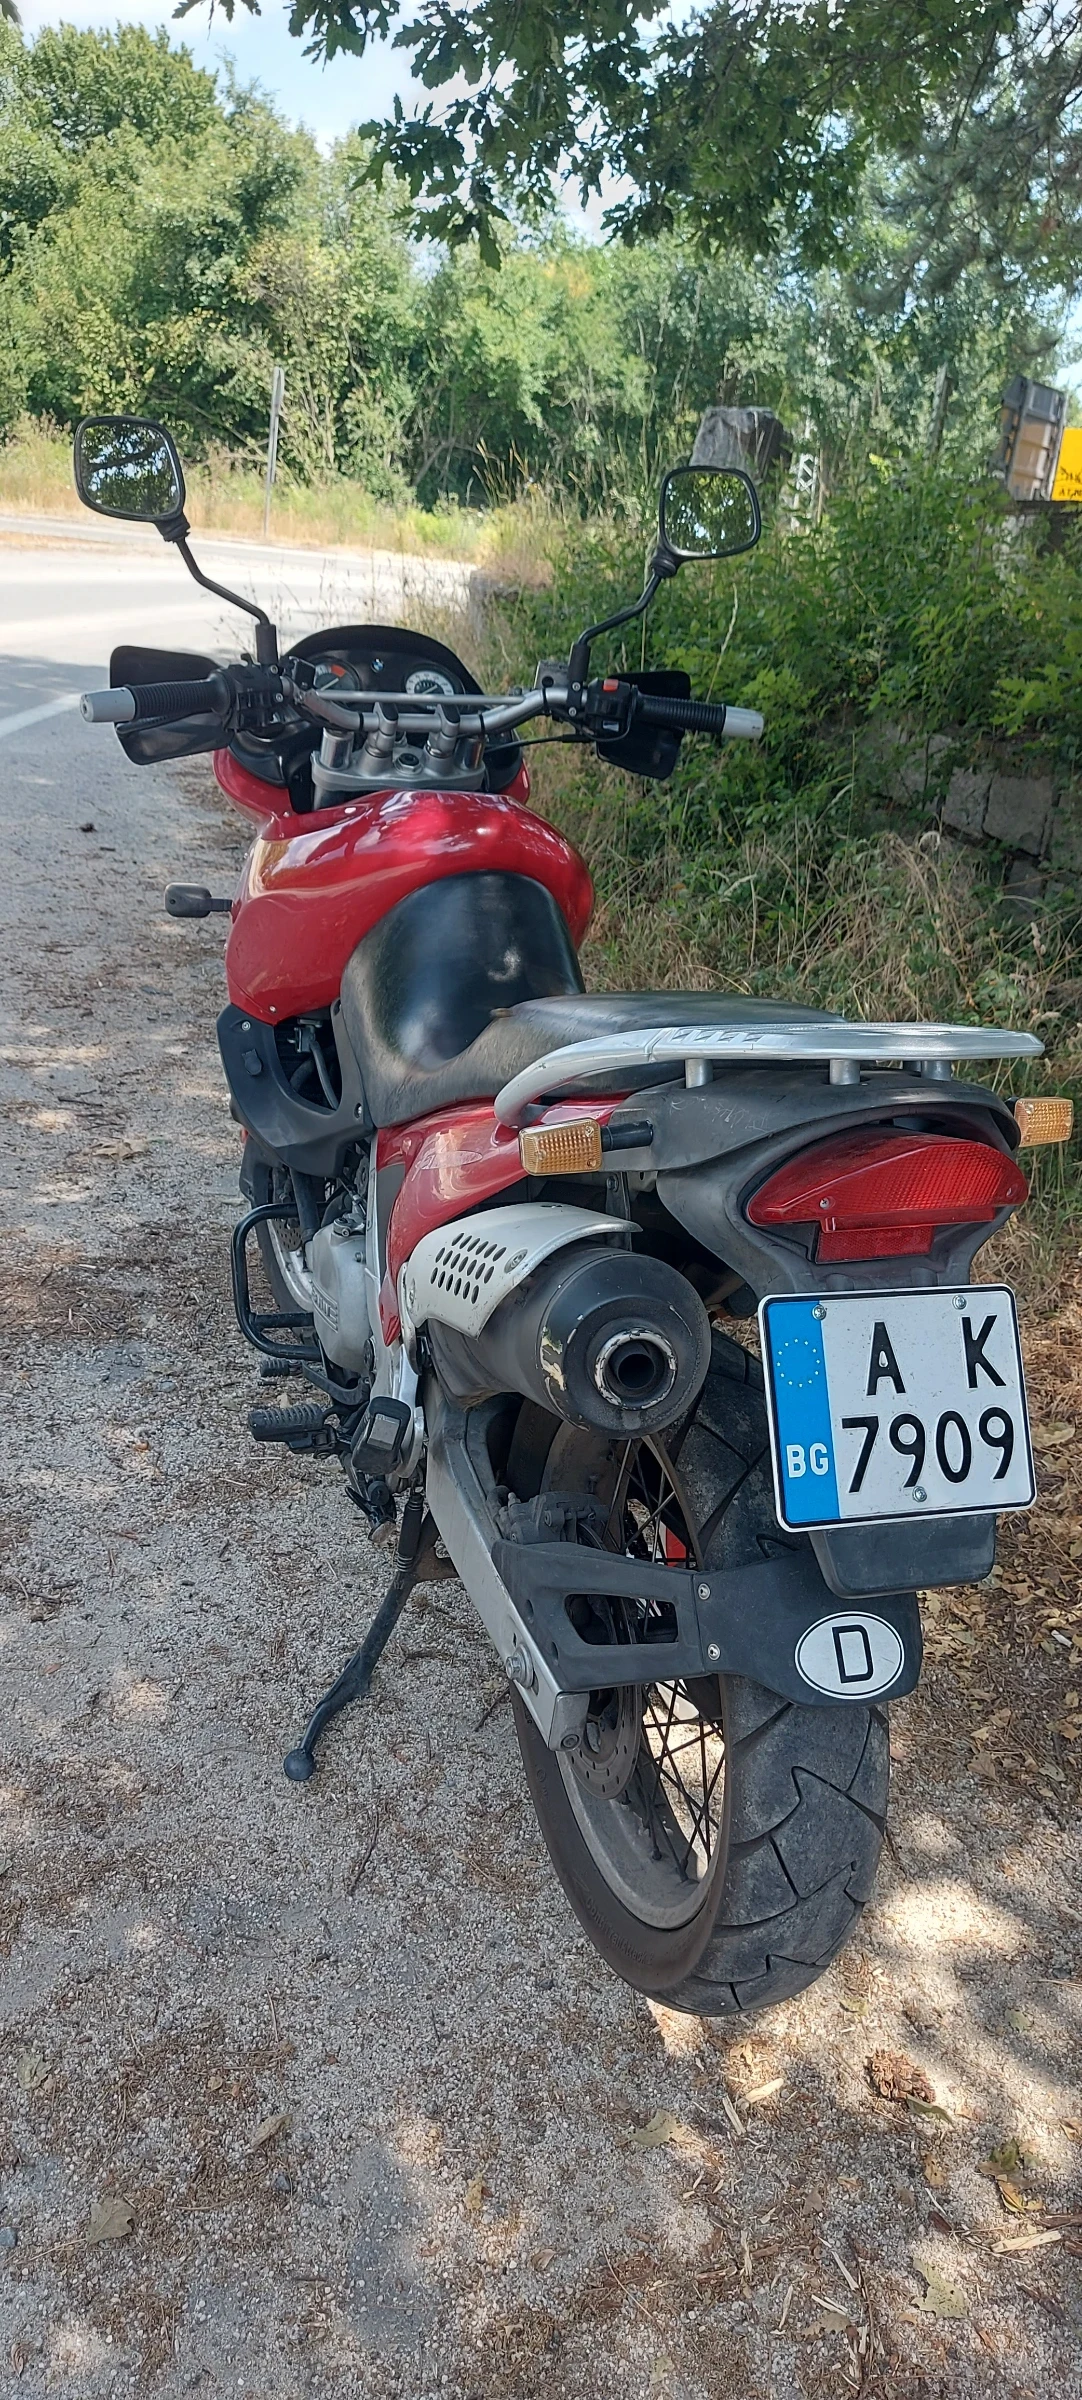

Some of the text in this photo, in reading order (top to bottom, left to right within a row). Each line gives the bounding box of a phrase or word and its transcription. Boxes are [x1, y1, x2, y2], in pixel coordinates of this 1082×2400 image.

[866, 1314, 1007, 1396] A K
[786, 1444, 829, 1478] BG
[841, 1406, 1015, 1494] 7909
[831, 1624, 874, 1684] D
